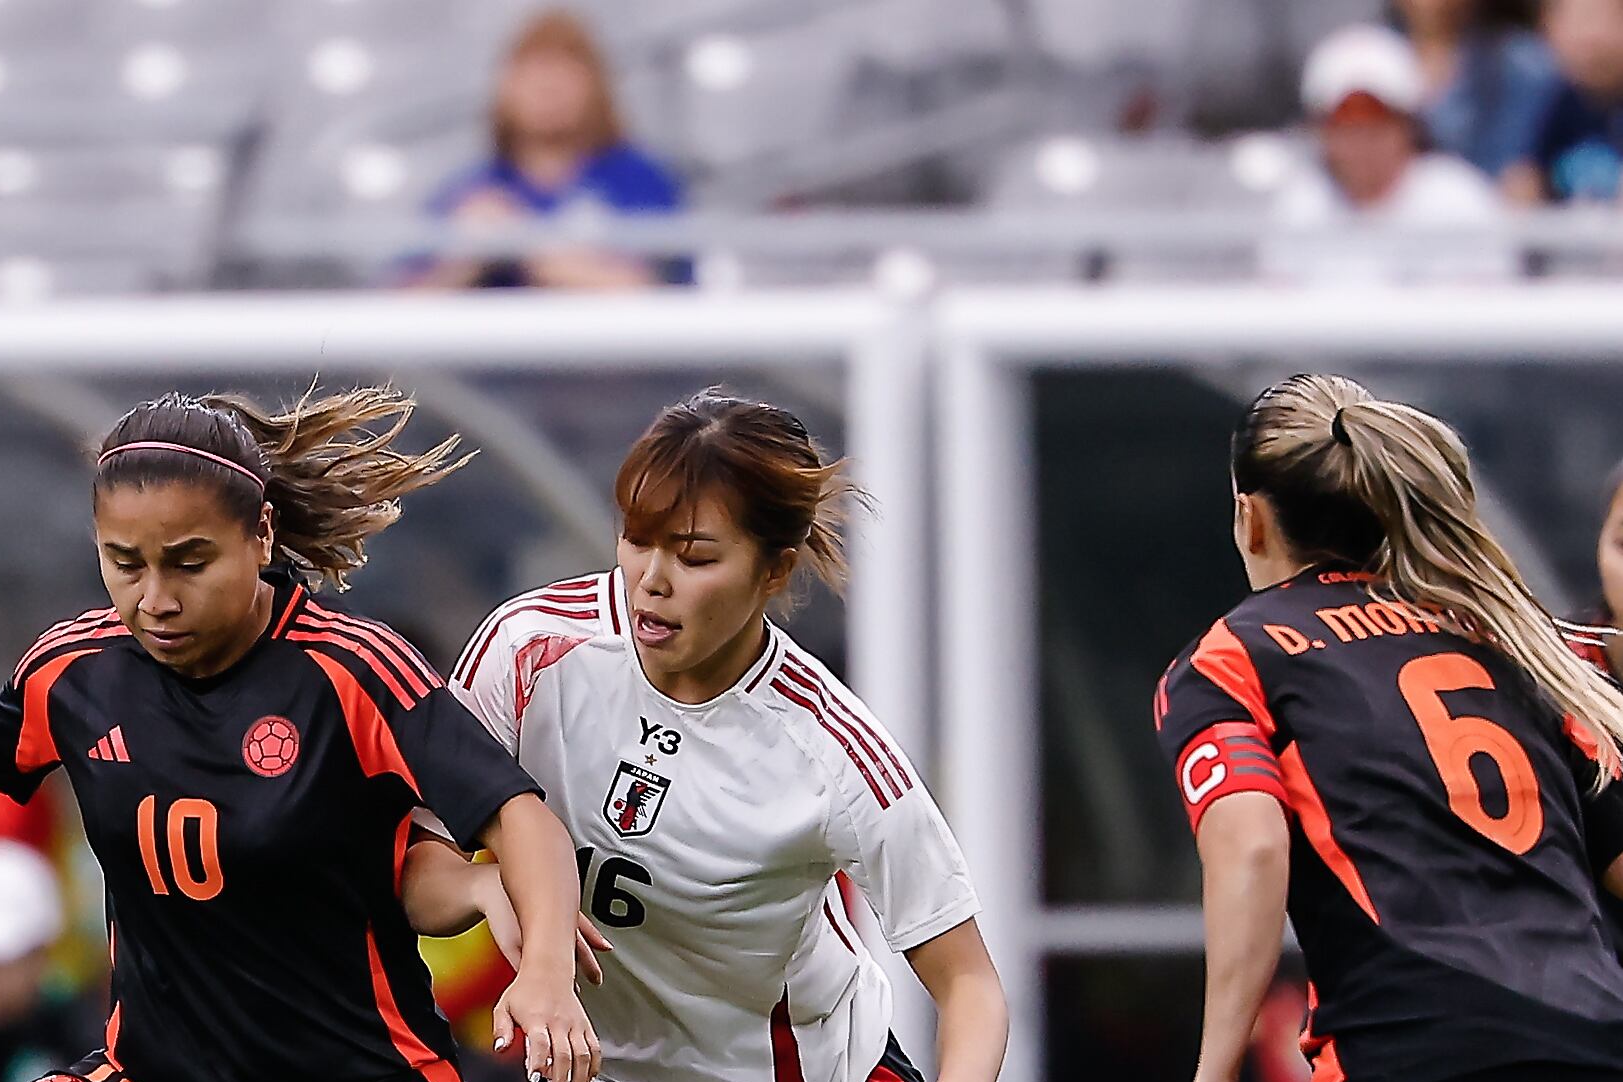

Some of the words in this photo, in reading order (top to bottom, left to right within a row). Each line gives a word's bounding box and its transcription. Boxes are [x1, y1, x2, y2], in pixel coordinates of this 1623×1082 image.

[1263, 624, 1327, 657] D.
[639, 715, 682, 755] Y-3
[1397, 652, 1544, 855] 6
[629, 767, 660, 784] JAPAN
[1182, 742, 1226, 804] C
[138, 794, 223, 900] 10
